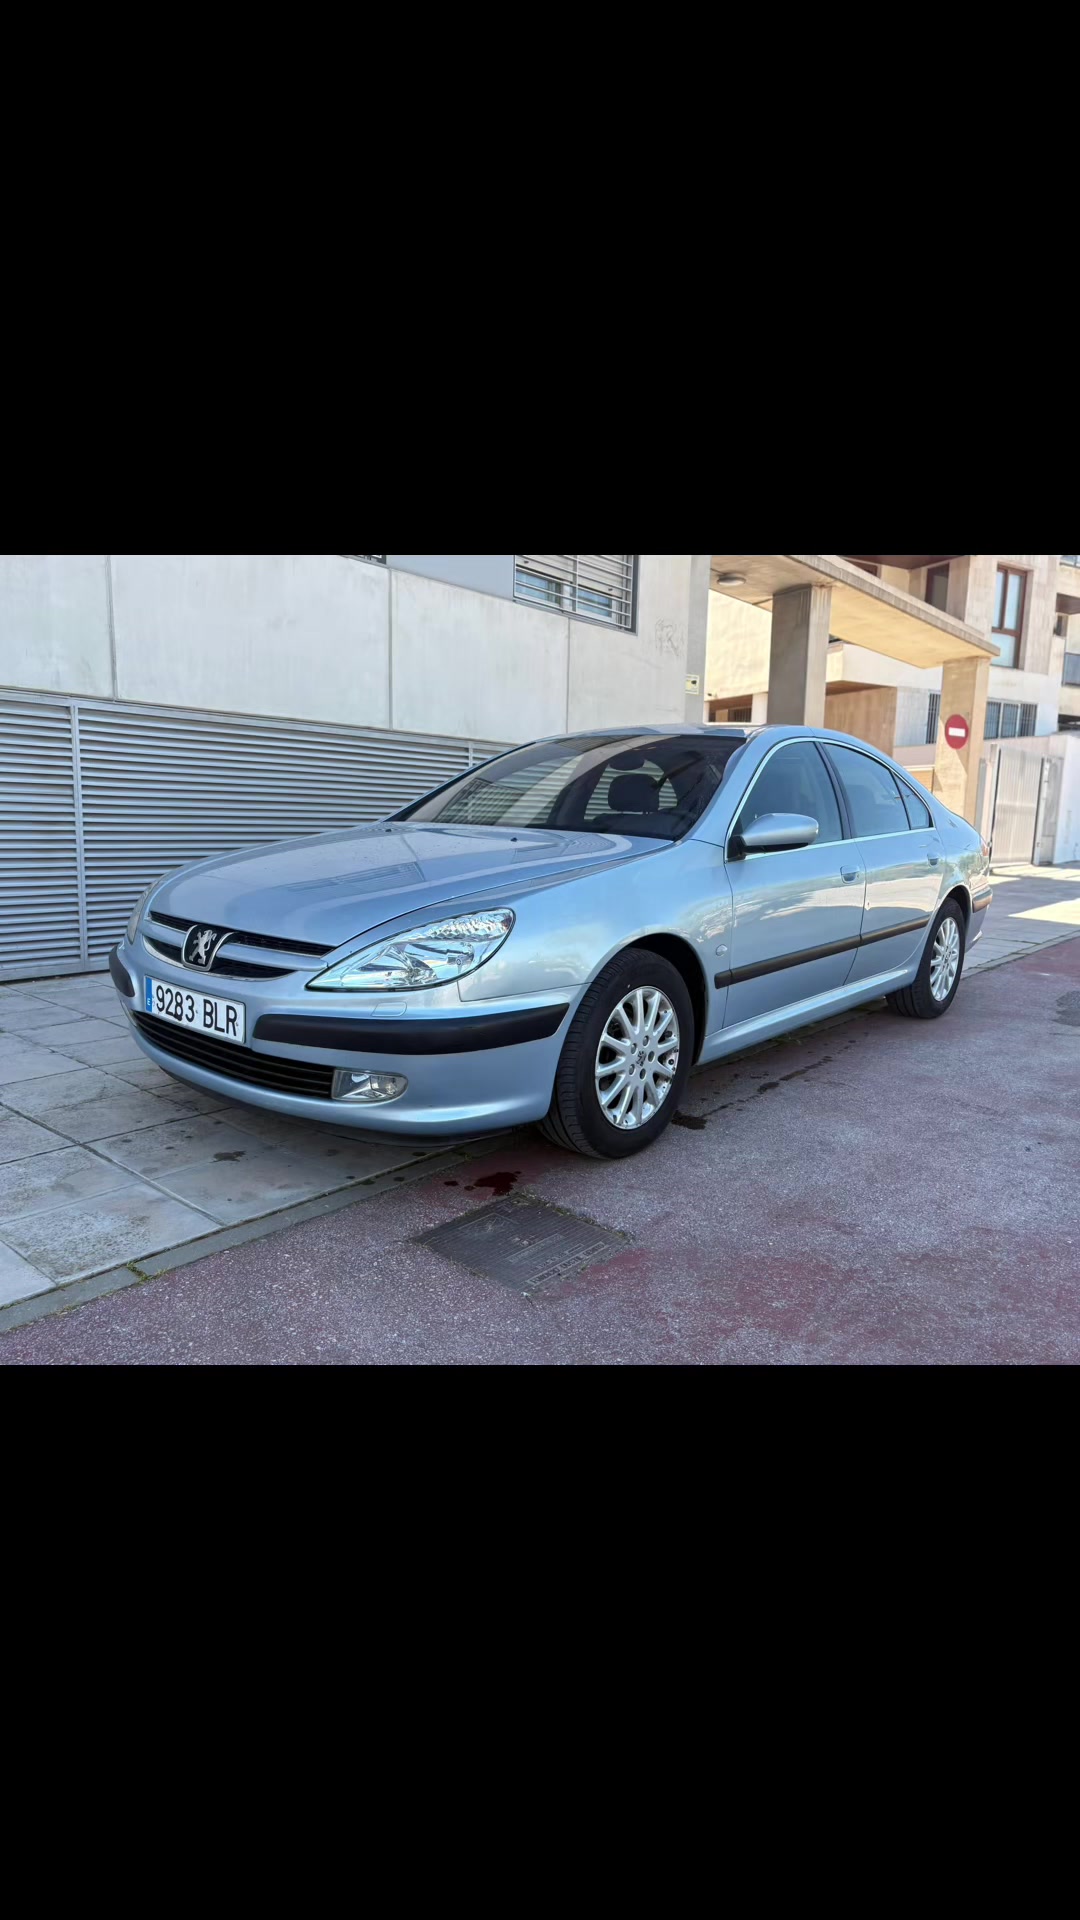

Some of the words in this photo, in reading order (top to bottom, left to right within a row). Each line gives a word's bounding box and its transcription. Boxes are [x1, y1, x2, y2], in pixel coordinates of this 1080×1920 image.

[147, 998, 151, 1006] E
[156, 985, 195, 1022] 9283
[203, 999, 237, 1036] BLR
